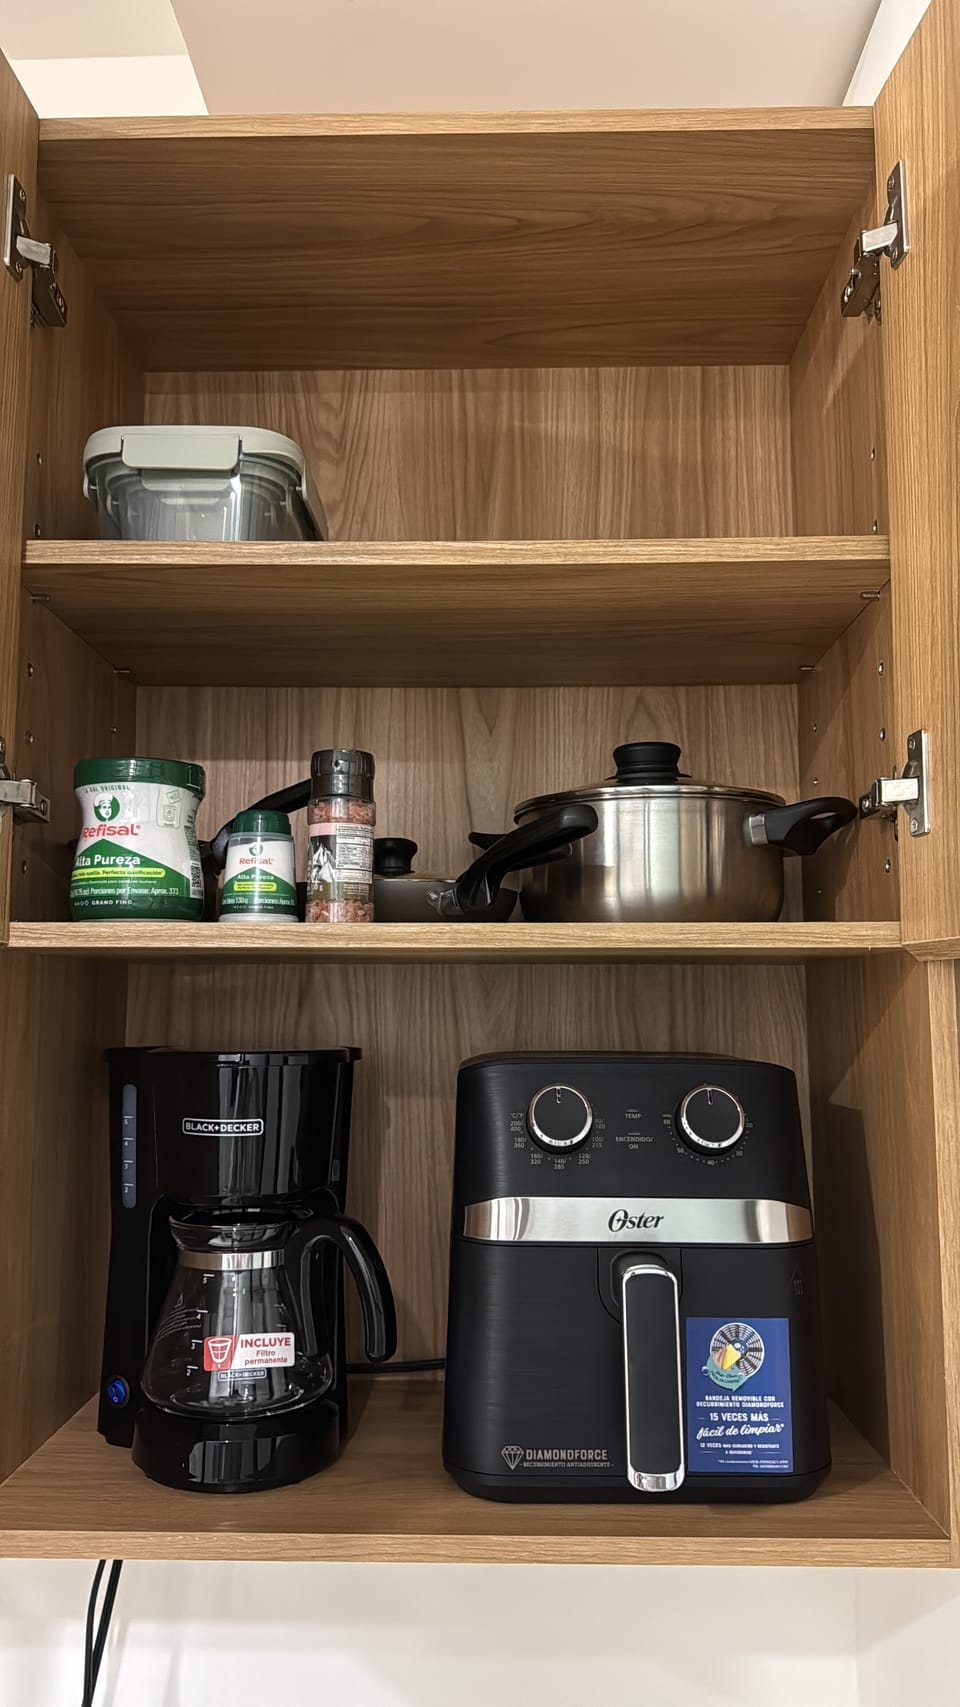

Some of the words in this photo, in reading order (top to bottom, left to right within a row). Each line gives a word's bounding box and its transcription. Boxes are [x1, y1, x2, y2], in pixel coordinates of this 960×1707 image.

[82, 823, 141, 839] Refisal
[75, 855, 91, 867] Alta
[93, 854, 141, 865] Pureza
[116, 888, 127, 896] por
[185, 1121, 260, 1133] BLACK+DECKER
[615, 1136, 654, 1144] ENCENDIDO/
[608, 1208, 665, 1233] Oster
[202, 1277, 208, 1285] 5
[190, 1342, 196, 1350] 3
[240, 1336, 292, 1349] INCLUYE
[256, 1349, 276, 1357] Filtro
[244, 1356, 288, 1366] permanente
[709, 1412, 719, 1422] 15
[721, 1412, 748, 1422] VECES
[750, 1410, 769, 1422] MÁS
[696, 1425, 725, 1440] fácil
[725, 1424, 739, 1436] de
[526, 1449, 608, 1460] DIAMONDFORCE
